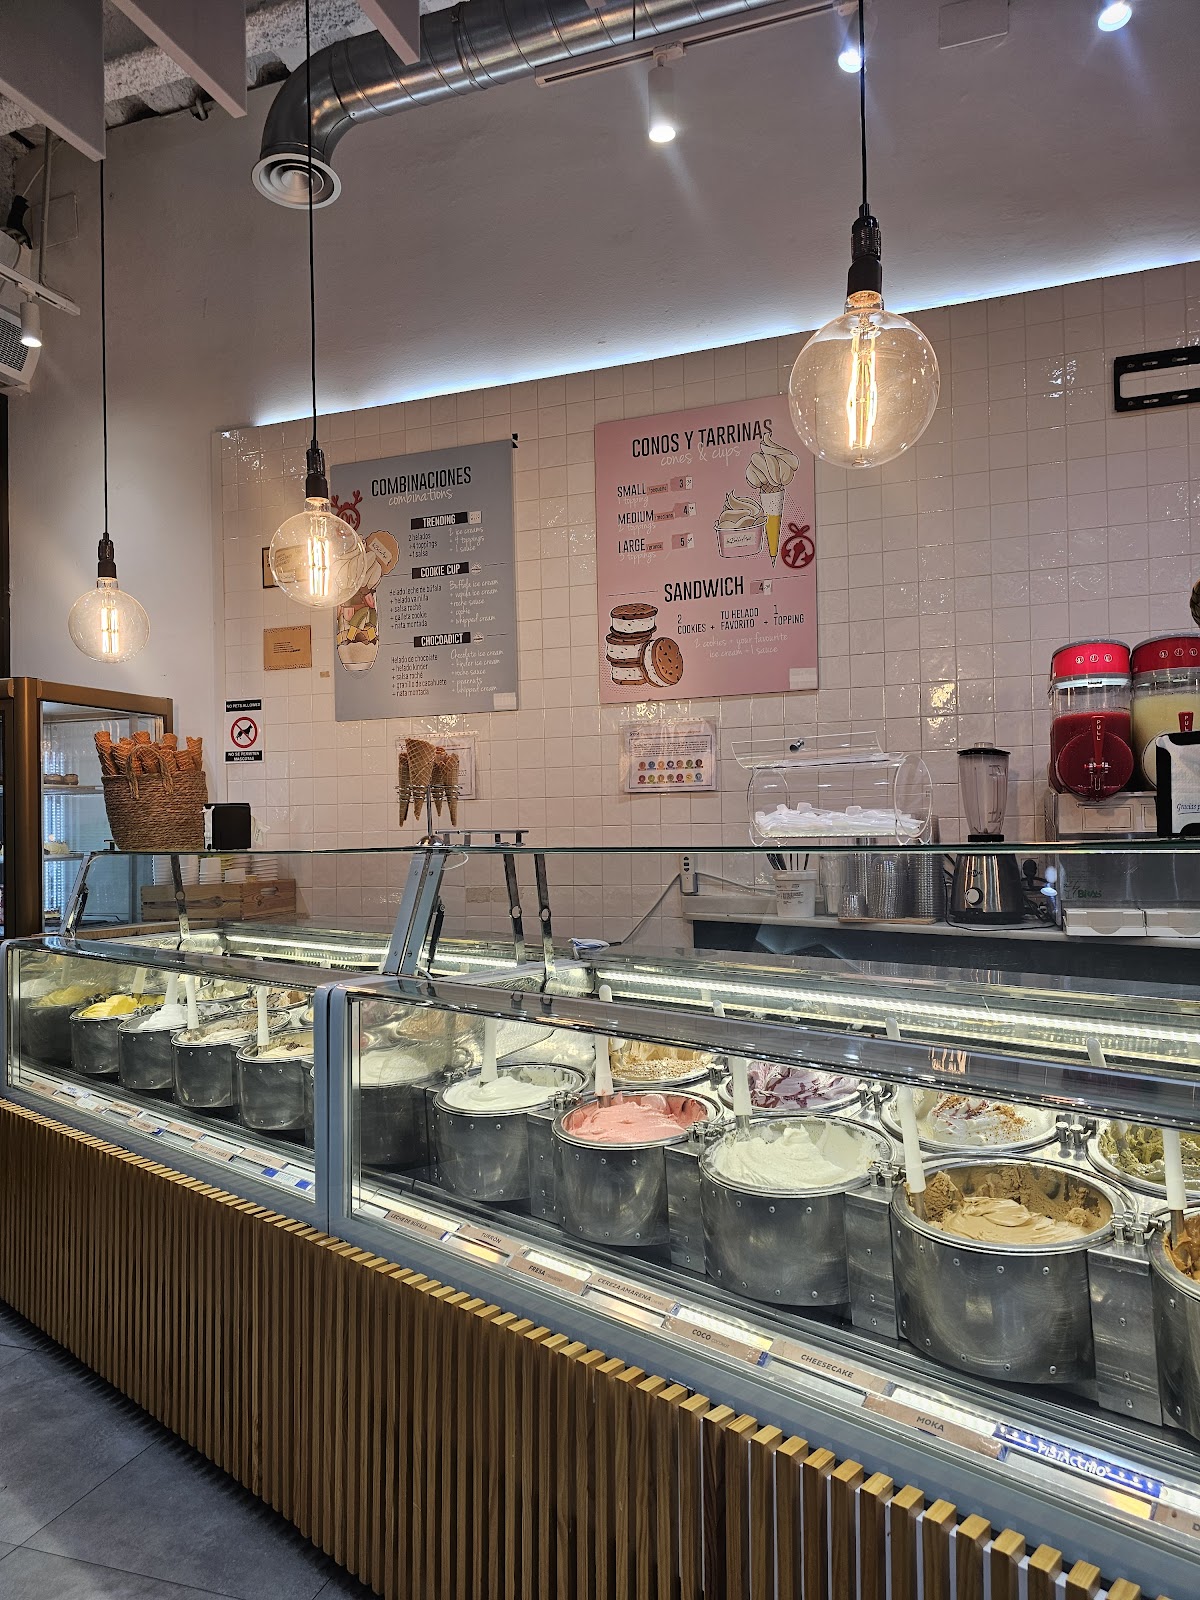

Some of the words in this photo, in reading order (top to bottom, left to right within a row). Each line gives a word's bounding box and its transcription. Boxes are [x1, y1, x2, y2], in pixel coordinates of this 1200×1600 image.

[632, 433, 679, 457] CONOS
[685, 431, 694, 449] Y
[698, 419, 773, 448] TARRINAS
[661, 453, 693, 466] cones
[698, 442, 707, 462] &
[712, 446, 742, 466] cups
[371, 466, 472, 496] COMBINACIONES
[388, 488, 453, 506] combinations
[617, 483, 646, 497] SMALL
[624, 496, 649, 508] topping
[422, 514, 456, 528] TRENDING
[618, 510, 654, 525] MEDIUM
[464, 526, 484, 534] creams
[627, 522, 656, 535] toppings
[461, 535, 485, 548] toppings
[618, 538, 645, 553] LARGE
[680, 537, 685, 546] 5
[627, 552, 656, 565] toppings
[421, 565, 445, 578] COOKIE
[447, 563, 461, 575] CUP
[664, 576, 744, 603] SANDWICH
[721, 610, 730, 620] TU
[731, 607, 759, 619] HELADO
[773, 604, 779, 615] 1
[677, 614, 682, 624] 2
[677, 624, 707, 634] COOKIES
[721, 619, 755, 630] FAVORITO
[773, 613, 805, 626] TOPPING
[421, 633, 464, 647] CHOCOADICT
[703, 635, 727, 648] cookies
[736, 637, 754, 649] your
[755, 632, 788, 645] favourite
[709, 650, 719, 658] ice
[721, 648, 742, 657] cream
[755, 646, 778, 656] sauce
[1176, 803, 1197, 812] Gracias
[390, 1213, 404, 1222] LECHE
[403, 1217, 411, 1225] DE
[411, 1219, 428, 1231] BÚFALA
[481, 1231, 502, 1244] TURRÓN
[528, 1264, 546, 1276] FRESA
[597, 1277, 621, 1294] CEREZA
[621, 1286, 652, 1302] AMARENA
[692, 1329, 712, 1341] COCO
[800, 1354, 854, 1378] CHEESECAKE
[916, 1415, 945, 1432] MOKA
